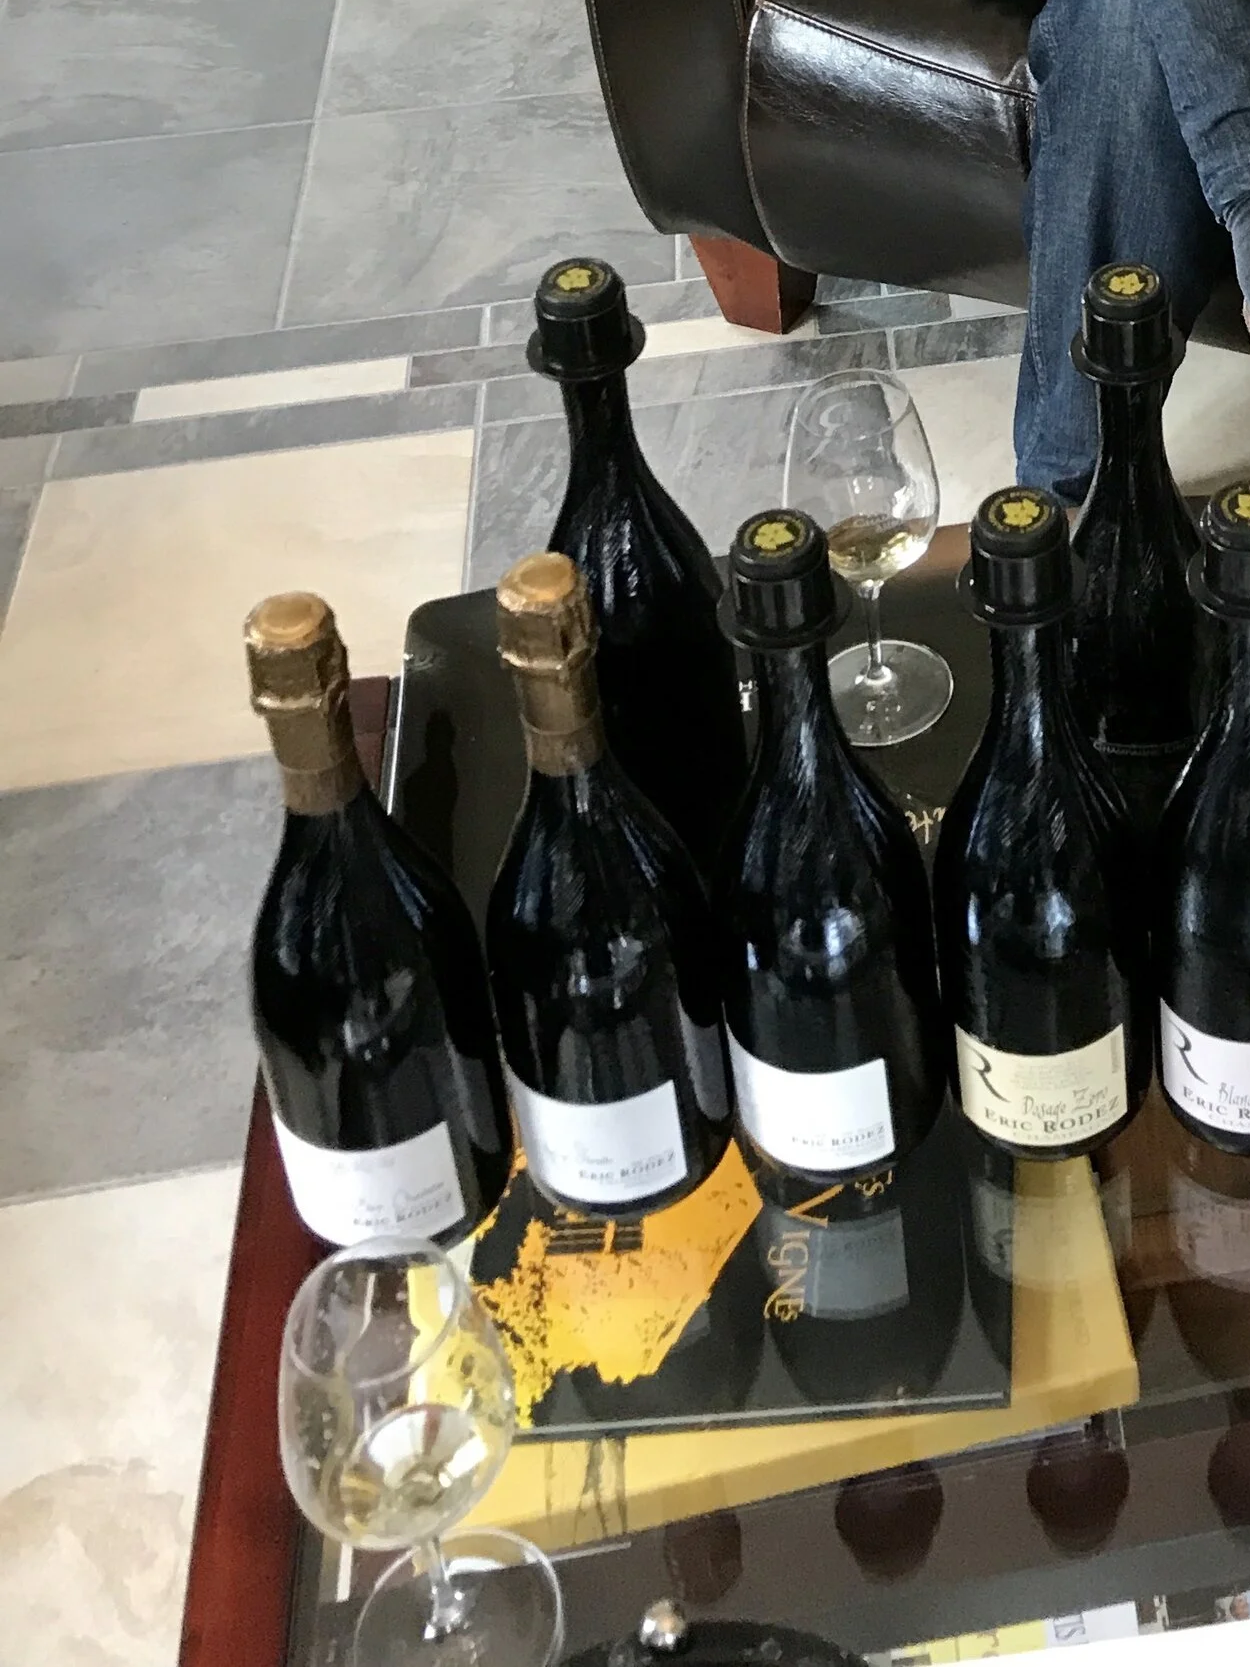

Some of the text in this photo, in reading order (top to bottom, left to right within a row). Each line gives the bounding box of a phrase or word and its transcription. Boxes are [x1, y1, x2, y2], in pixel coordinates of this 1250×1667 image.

[984, 1095, 1119, 1134] ERIC RODEZ
[1183, 1085, 1228, 1116] ERIC
[831, 1124, 885, 1147] RODEZ
[620, 1148, 675, 1179] RODEZ
